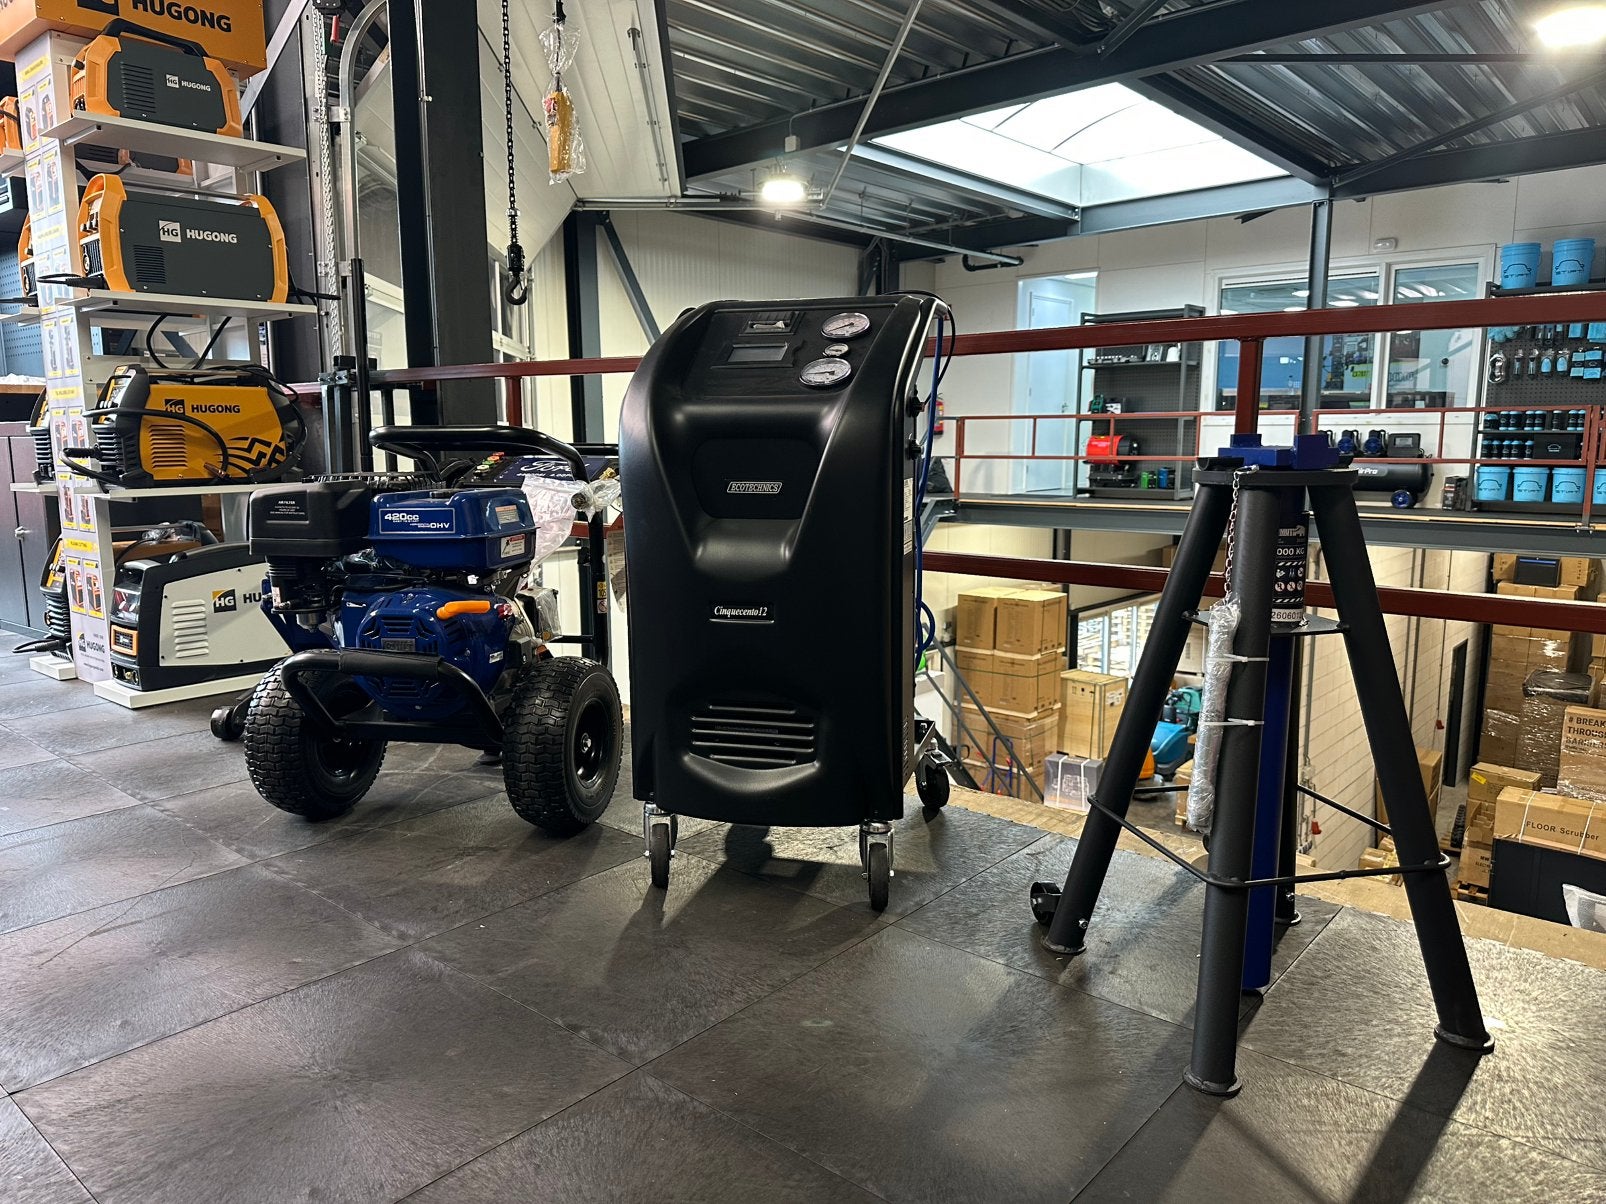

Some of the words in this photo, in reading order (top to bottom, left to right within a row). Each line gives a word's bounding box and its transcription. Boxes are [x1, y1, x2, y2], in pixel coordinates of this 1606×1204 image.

[132, 0, 232, 32] HUGONG
[181, 80, 211, 92] HUGONG
[186, 229, 238, 243] HUGONG
[191, 404, 241, 413] HUGONG
[520, 460, 572, 472] For
[731, 483, 779, 492] ECOTECHNICS
[384, 512, 419, 521] 420cc
[215, 596, 235, 608] HG
[714, 605, 768, 618] Cinquecento12
[1576, 717, 1606, 728] BREAK
[1567, 726, 1606, 739] THROUG
[1526, 820, 1556, 833] FLOOR
[1559, 827, 1600, 841] Scrubber
